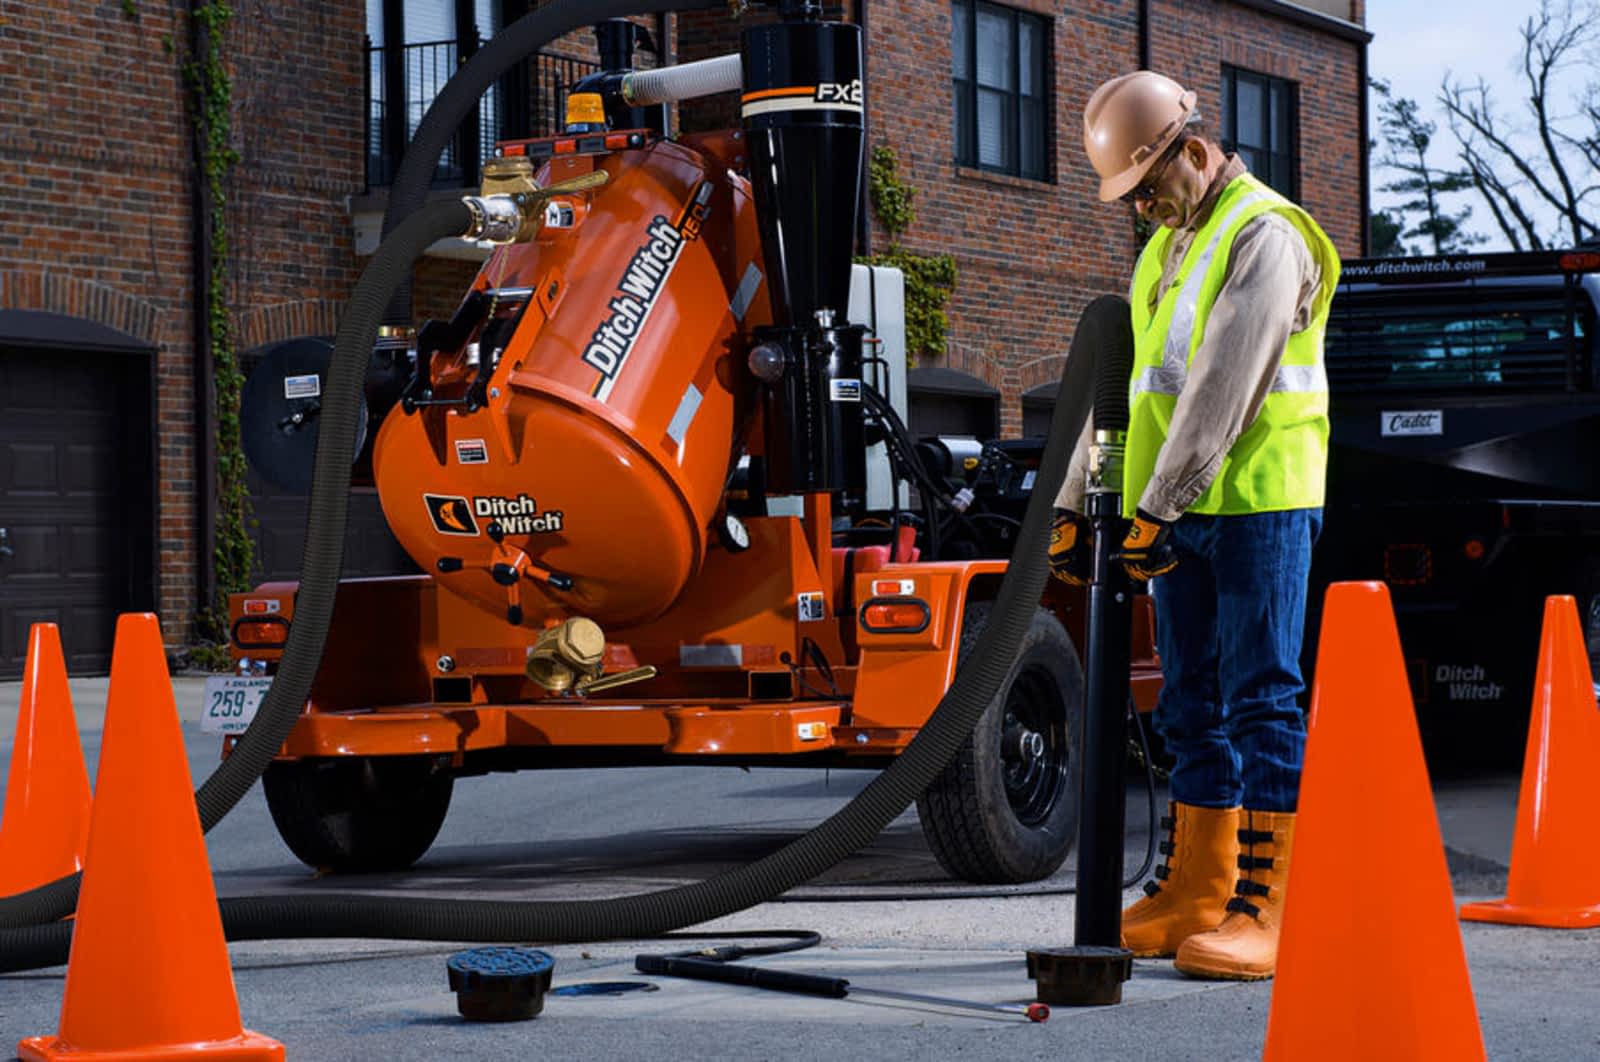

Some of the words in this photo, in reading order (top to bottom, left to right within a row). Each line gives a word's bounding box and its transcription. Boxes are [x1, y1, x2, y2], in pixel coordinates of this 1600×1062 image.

[584, 294, 645, 376] Ditch
[620, 219, 681, 301] Witch
[1389, 414, 1439, 433] Cadet
[475, 496, 534, 516] Ditch
[495, 512, 559, 533] Witch
[1436, 664, 1485, 682] Ditch
[1449, 682, 1501, 700] Witch
[209, 689, 270, 718] 259-7
